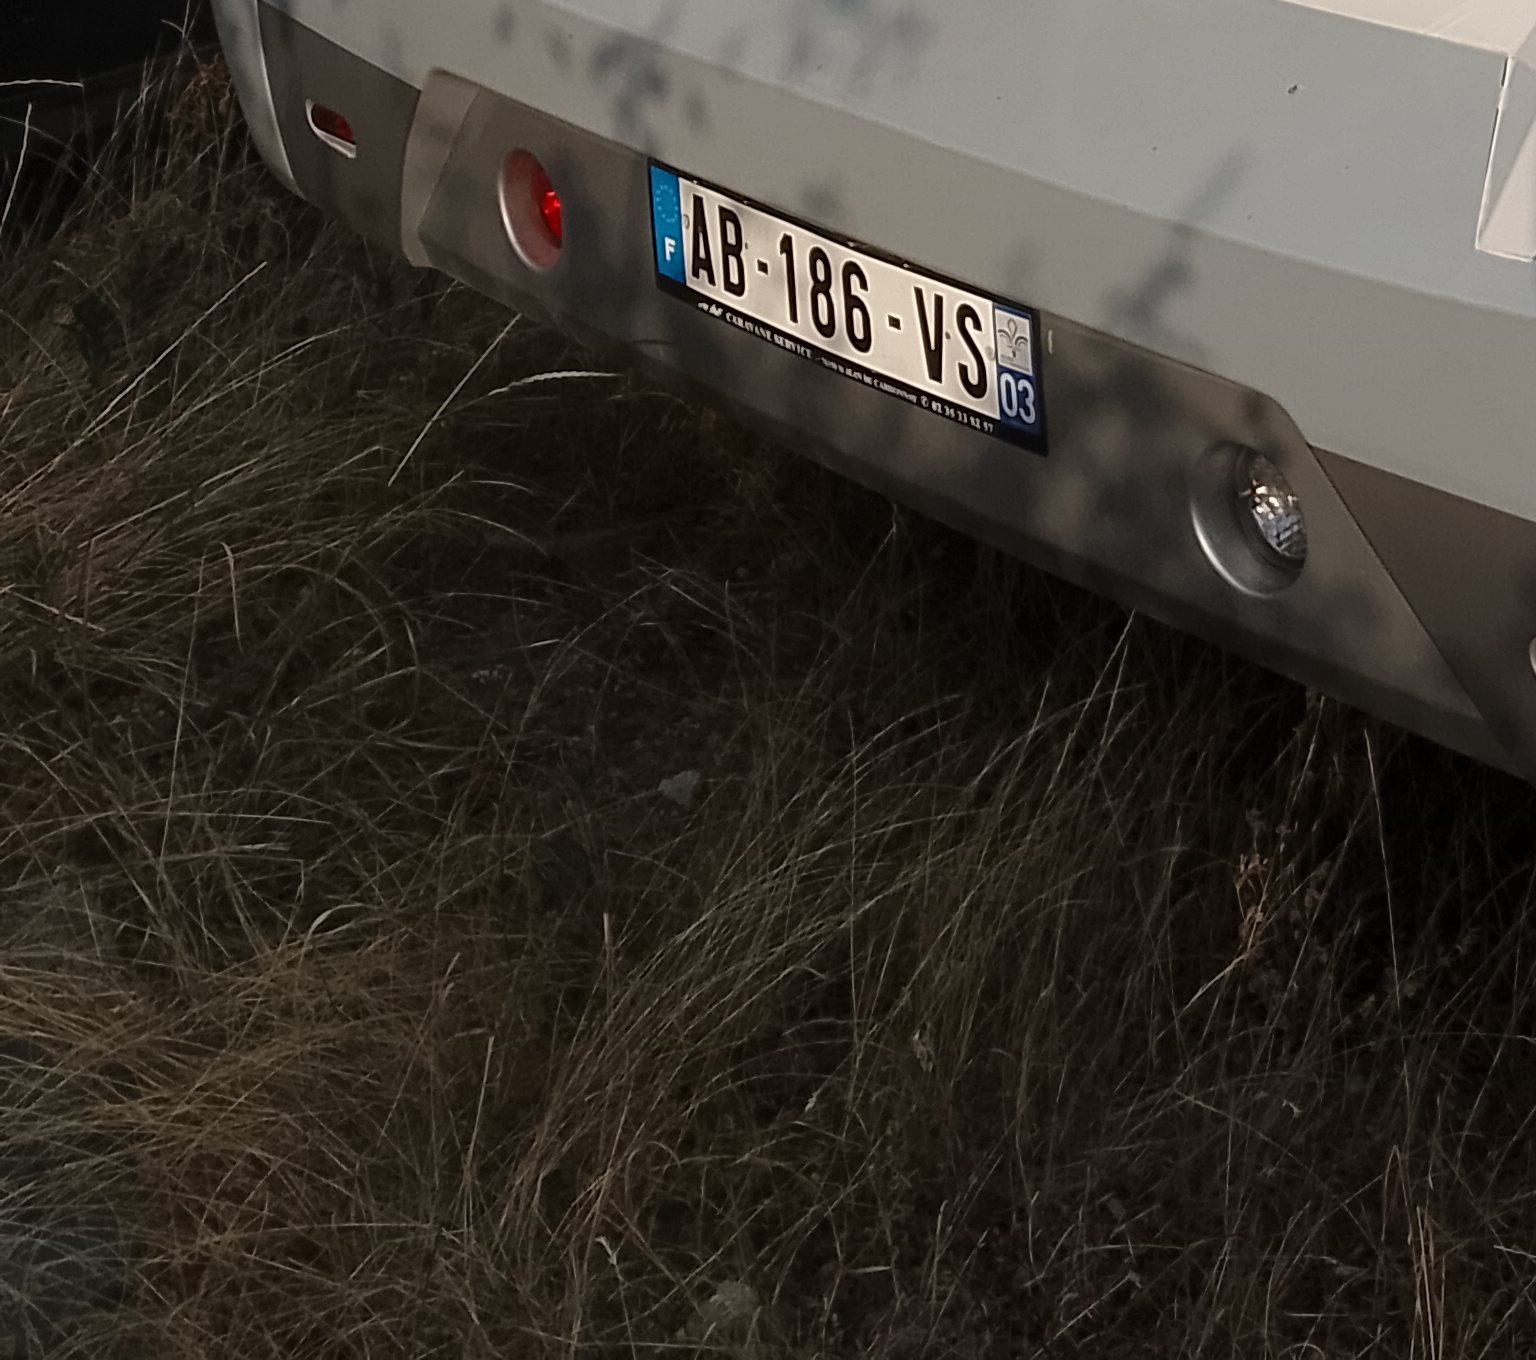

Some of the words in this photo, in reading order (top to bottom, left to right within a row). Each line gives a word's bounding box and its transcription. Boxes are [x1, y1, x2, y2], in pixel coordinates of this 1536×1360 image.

[664, 236, 676, 261] F
[773, 333, 812, 359] SERVICE
[1000, 372, 1036, 424] 03
